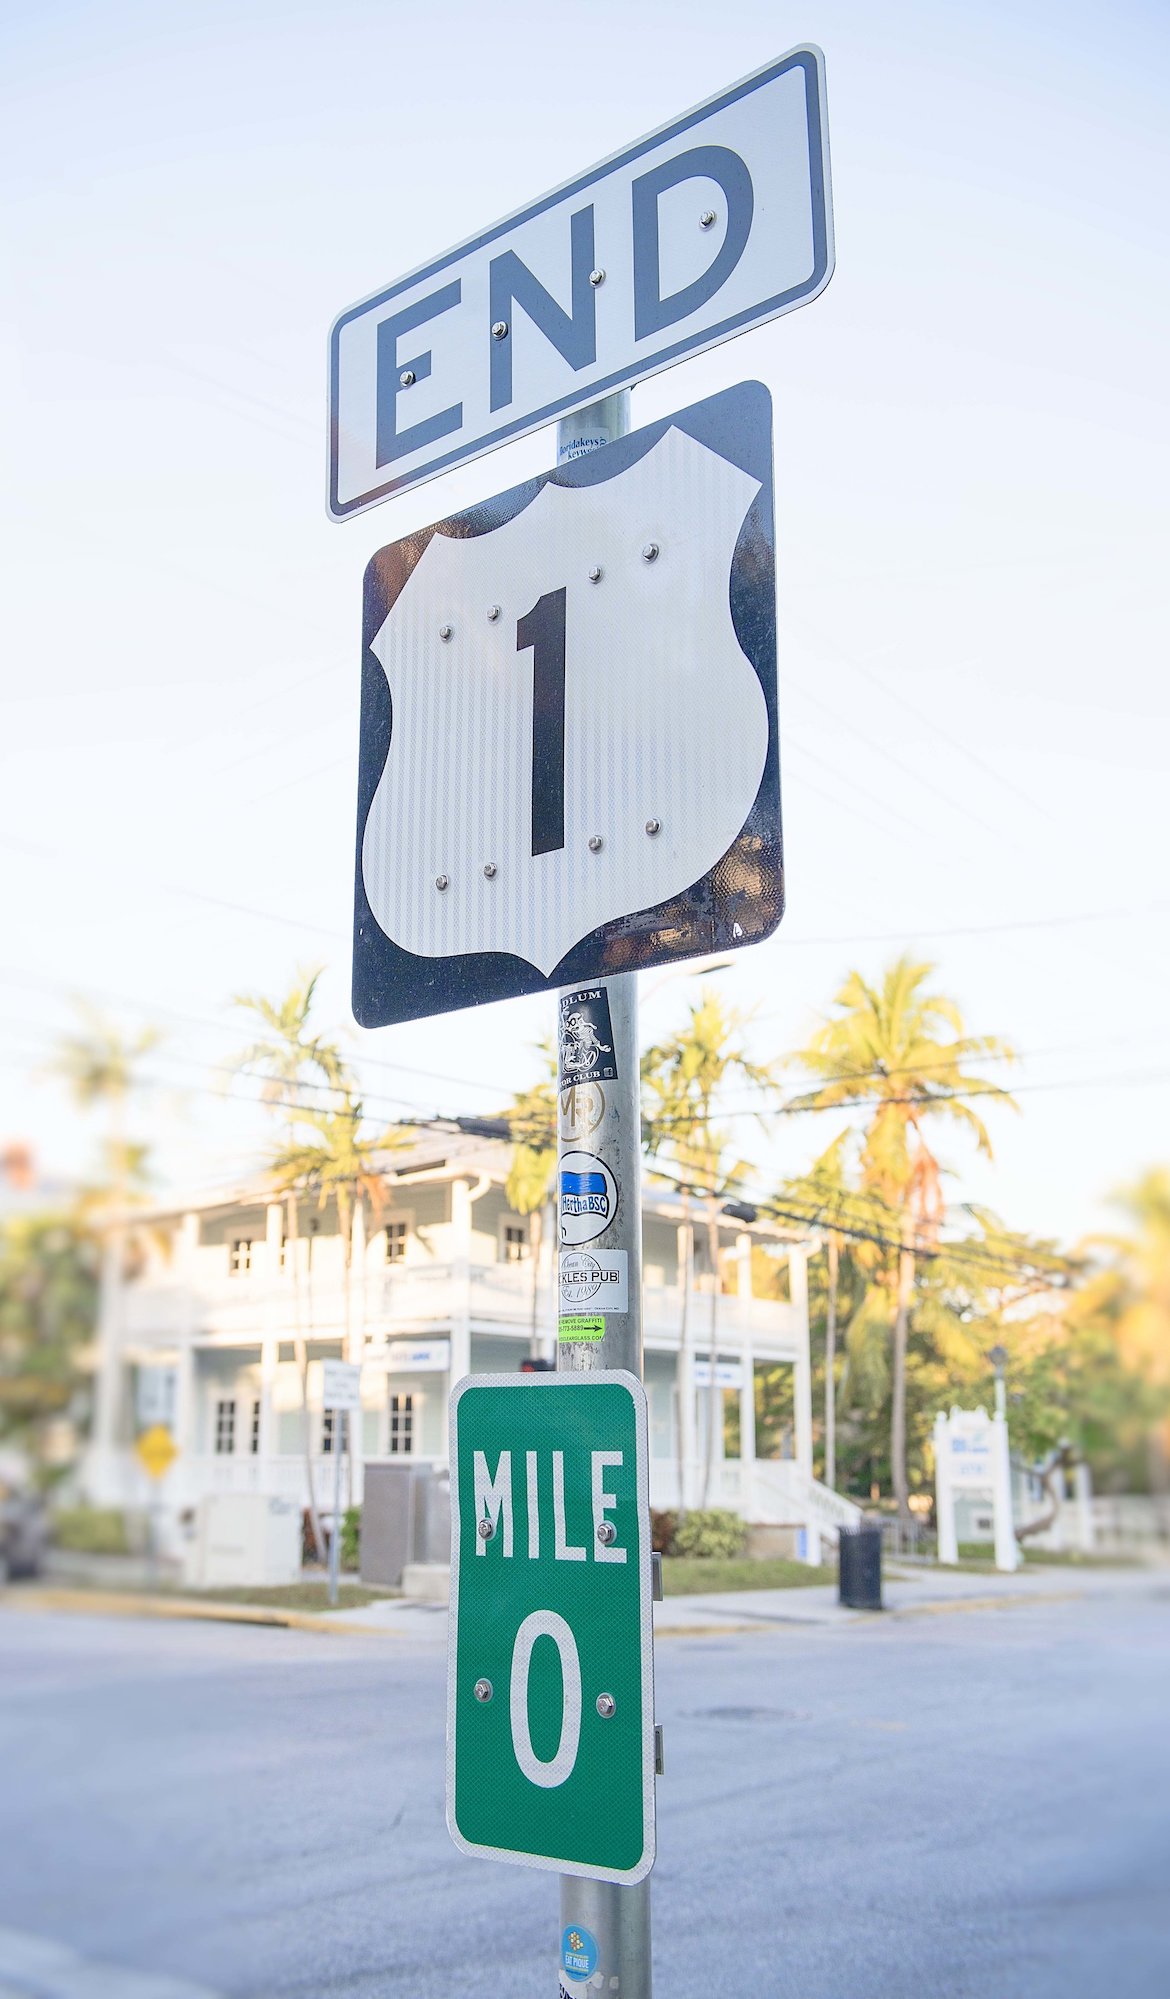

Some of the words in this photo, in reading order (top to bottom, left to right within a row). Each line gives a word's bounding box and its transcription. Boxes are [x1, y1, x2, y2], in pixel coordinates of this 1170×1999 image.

[376, 145, 753, 469] END
[516, 587, 567, 856] 1
[562, 991, 602, 1007] DLUM
[560, 1077, 572, 1086] OR
[573, 1070, 601, 1082] CLUB
[591, 1271, 618, 1282] PUB
[474, 1450, 627, 1563] MILE
[510, 1609, 582, 1788] 0
